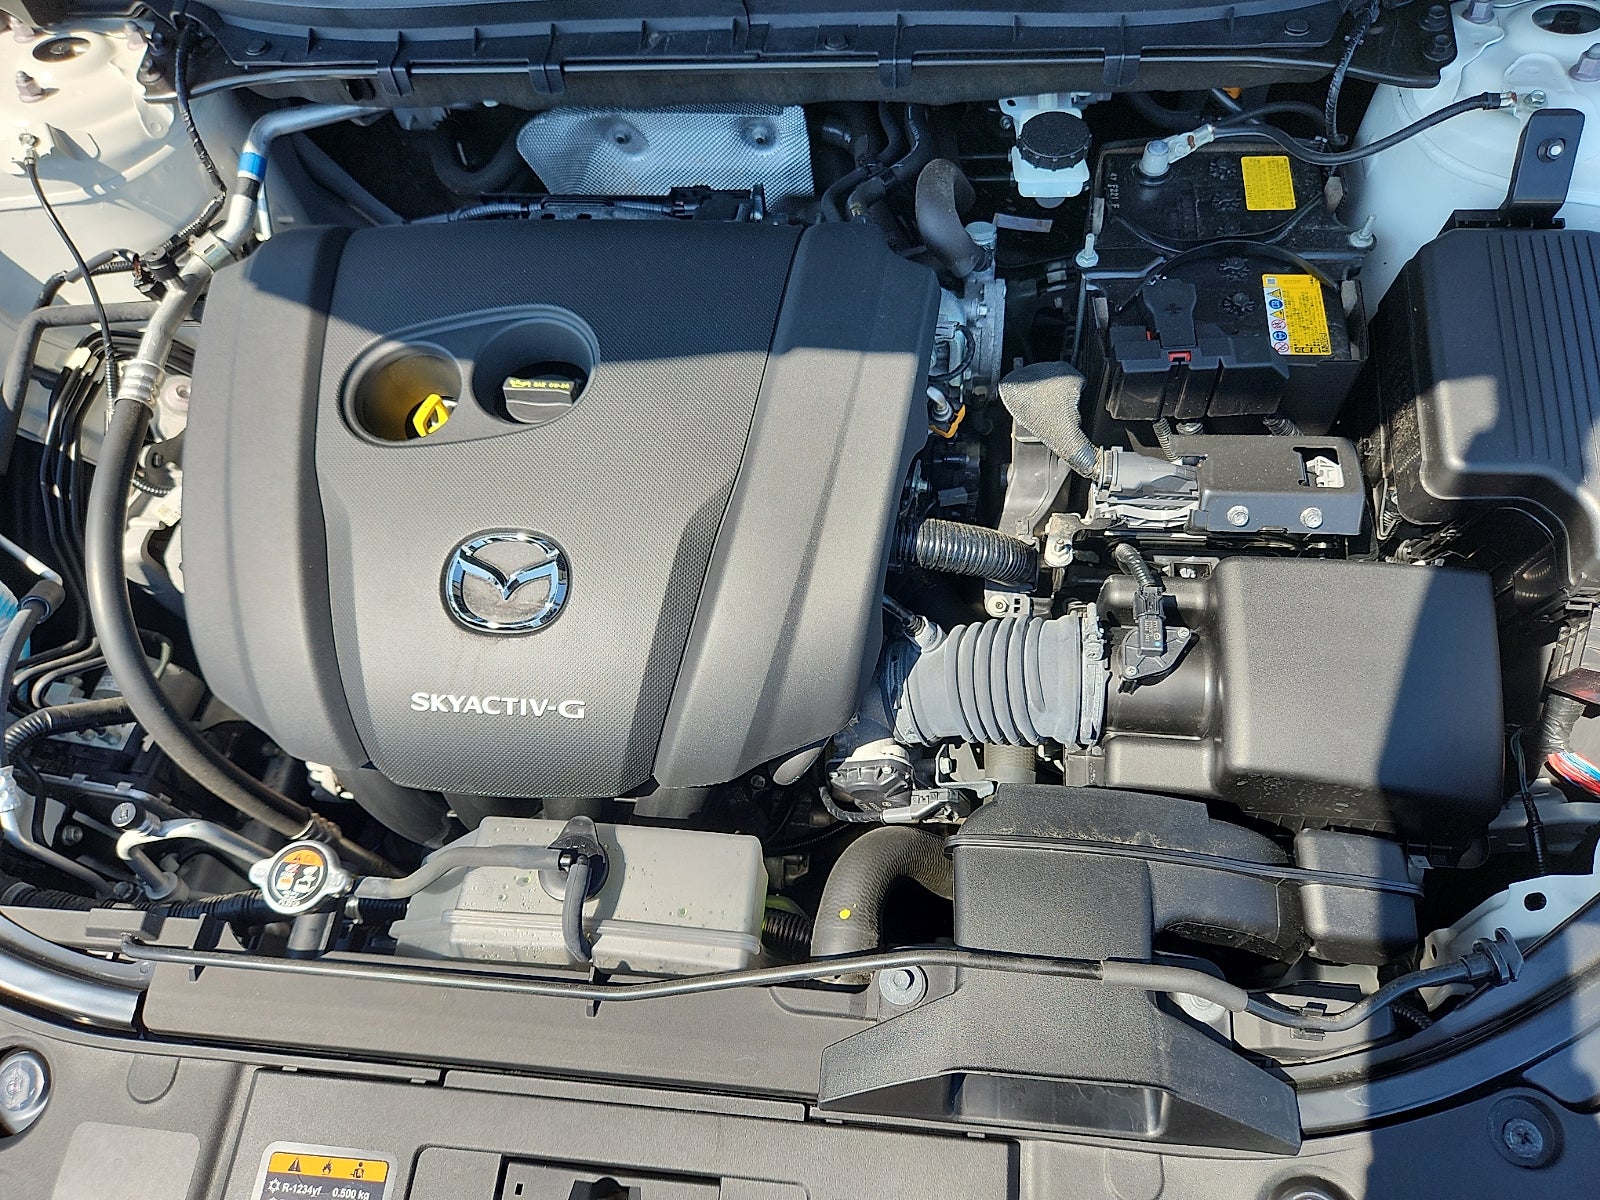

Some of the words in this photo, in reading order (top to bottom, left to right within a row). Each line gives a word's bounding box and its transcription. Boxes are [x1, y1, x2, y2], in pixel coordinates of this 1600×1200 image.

[410, 692, 586, 719] SKYACTIV-G
[281, 1182, 322, 1197] R-1234yf
[332, 1187, 357, 1199] 0.500
[358, 1189, 370, 1200] kg
